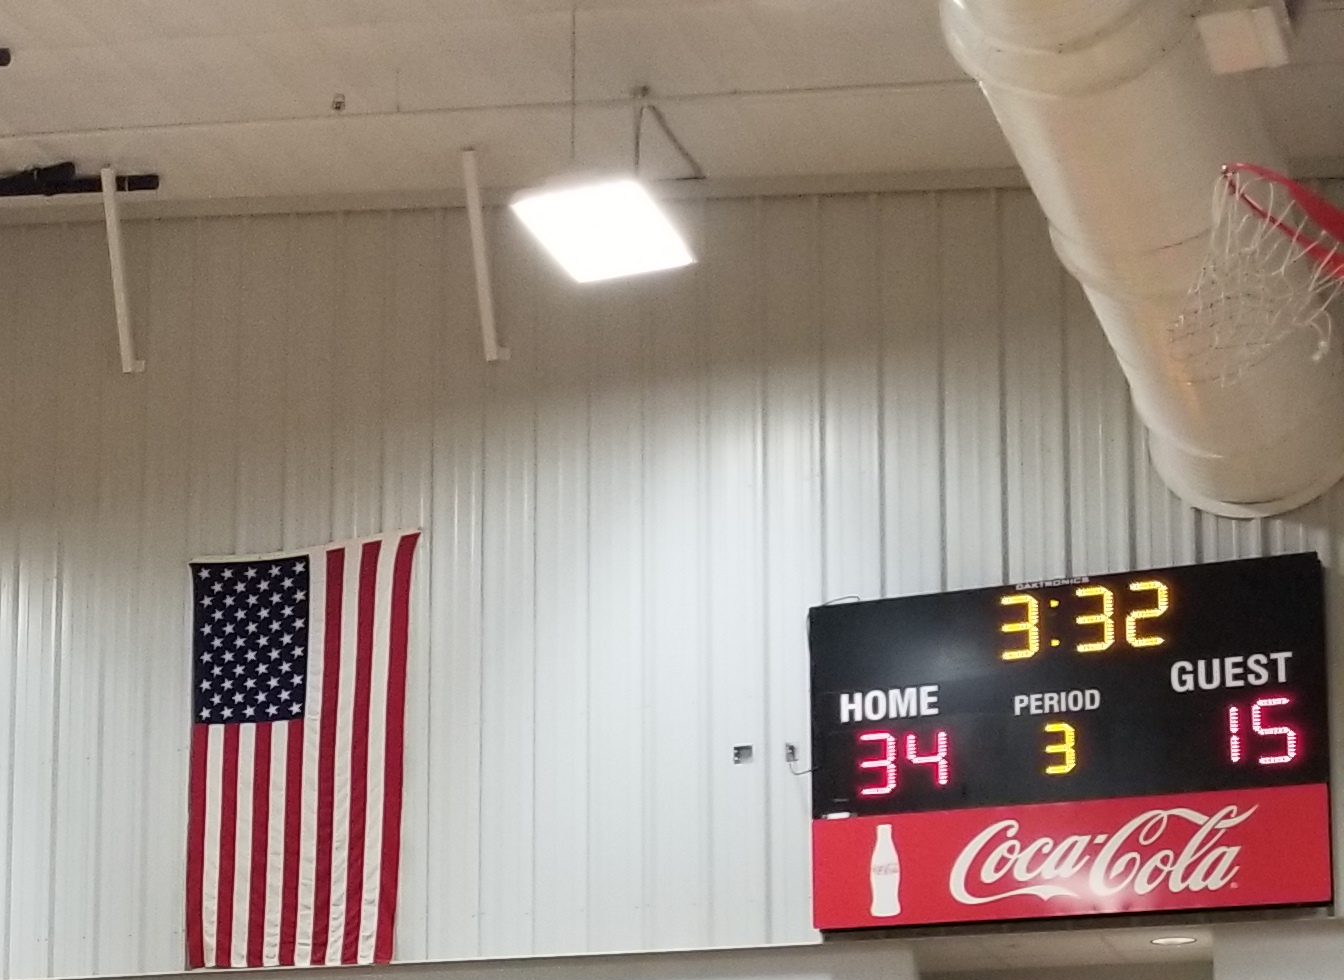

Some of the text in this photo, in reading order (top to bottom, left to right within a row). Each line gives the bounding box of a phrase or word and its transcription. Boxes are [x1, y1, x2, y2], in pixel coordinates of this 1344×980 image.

[1001, 580, 1169, 660] 3:32
[1170, 652, 1293, 693] GUEST
[840, 685, 940, 723] HOME
[1014, 689, 1101, 717] PERIOD
[1227, 697, 1298, 765] 15
[858, 730, 950, 796] 34
[1044, 721, 1077, 775] 3
[949, 804, 1259, 905] Coca-Cola
